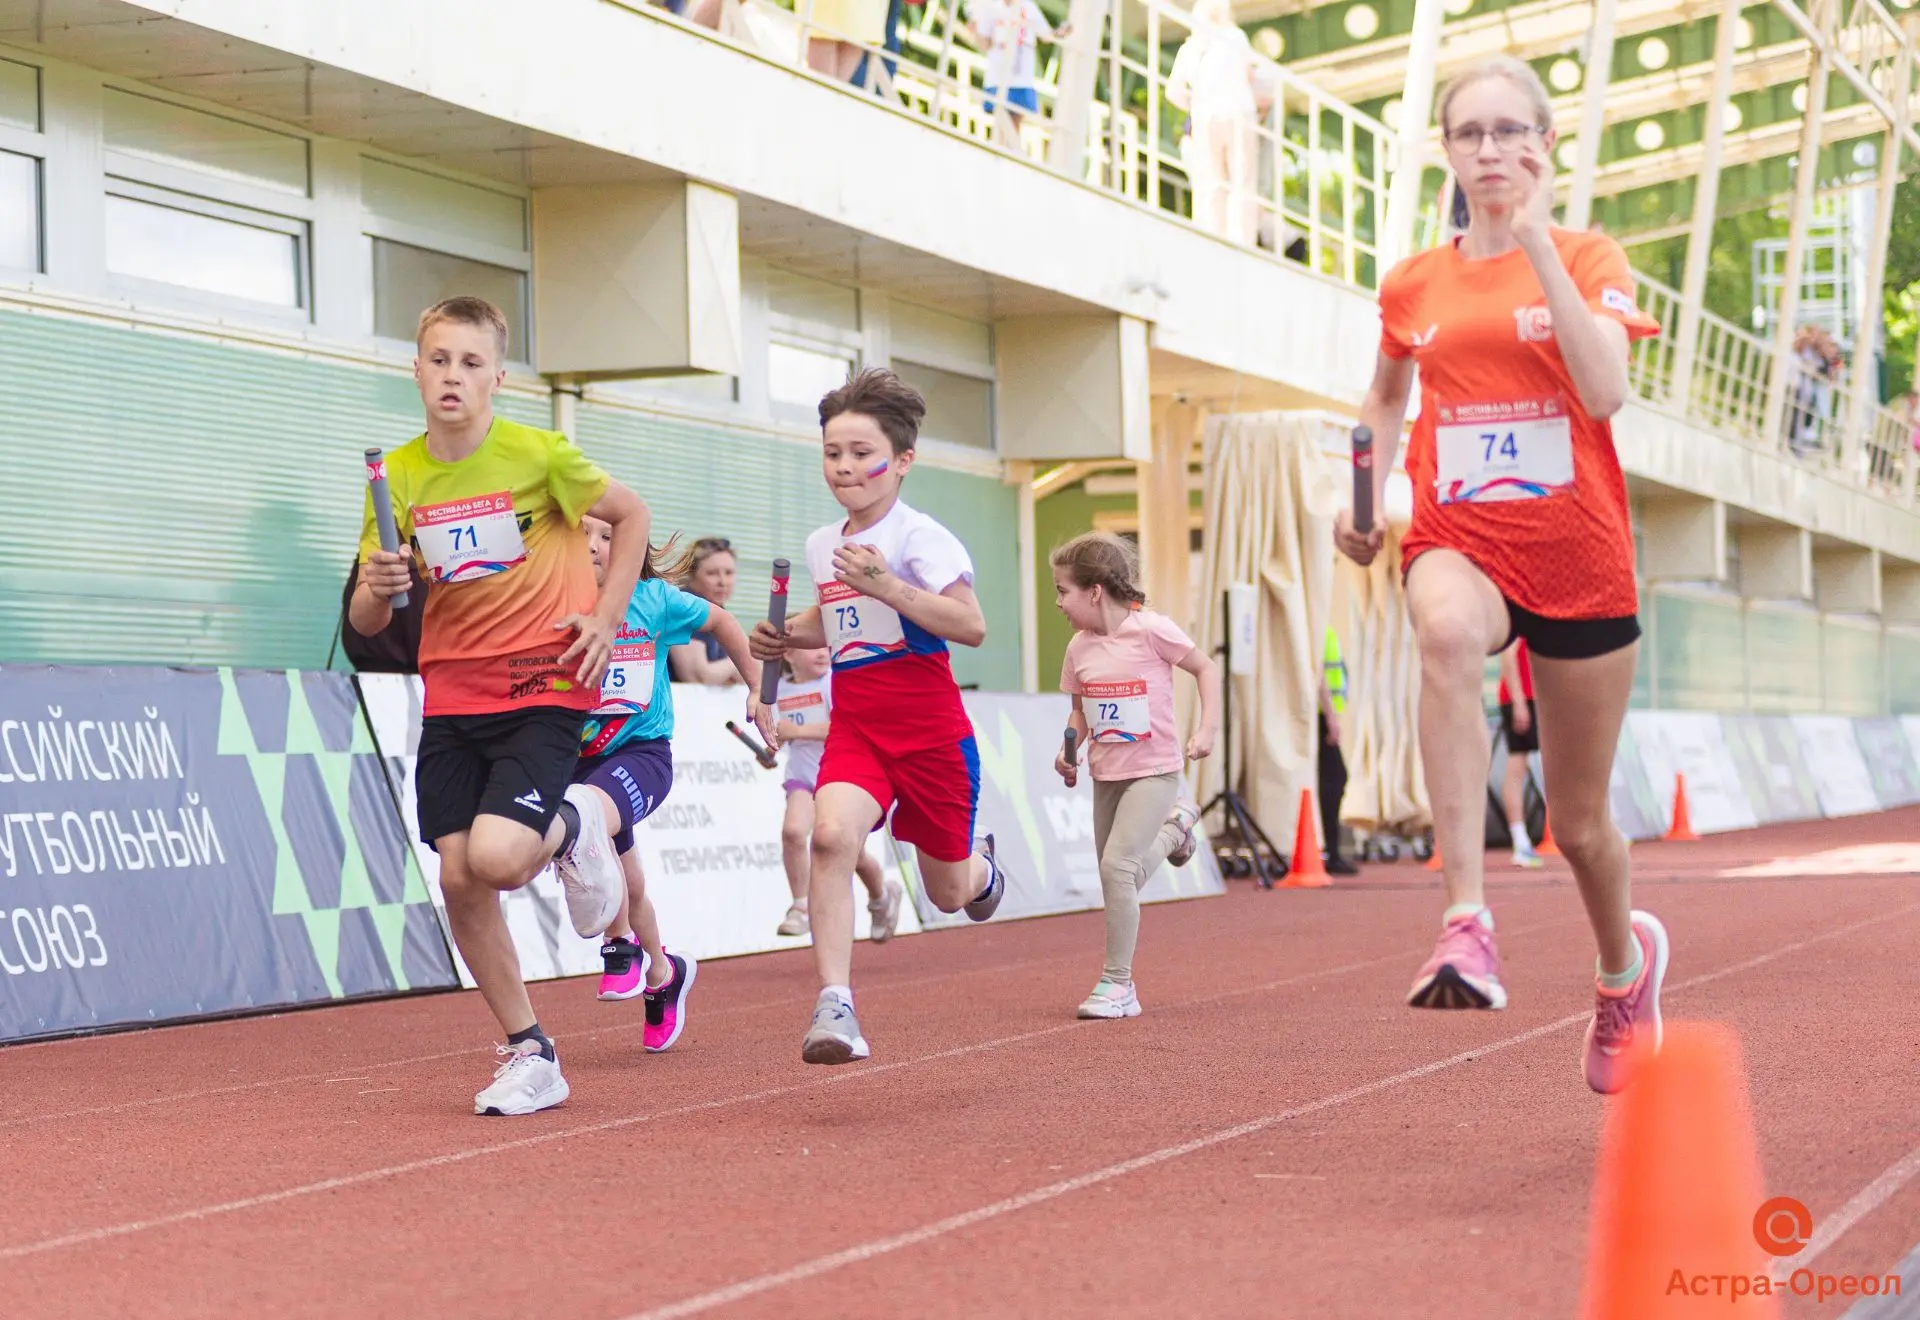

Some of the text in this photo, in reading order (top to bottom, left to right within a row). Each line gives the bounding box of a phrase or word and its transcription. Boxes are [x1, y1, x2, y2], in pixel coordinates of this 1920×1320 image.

[1480, 432, 1519, 462] 74
[427, 499, 492, 517] ФЕСТИВАЛЬ БЕГА
[448, 525, 477, 551] 71
[449, 548, 489, 560] МИРОСЛАВ
[836, 605, 860, 631] 73
[601, 667, 626, 688] 75
[509, 679, 547, 699] 2025
[1098, 703, 1120, 720] 72
